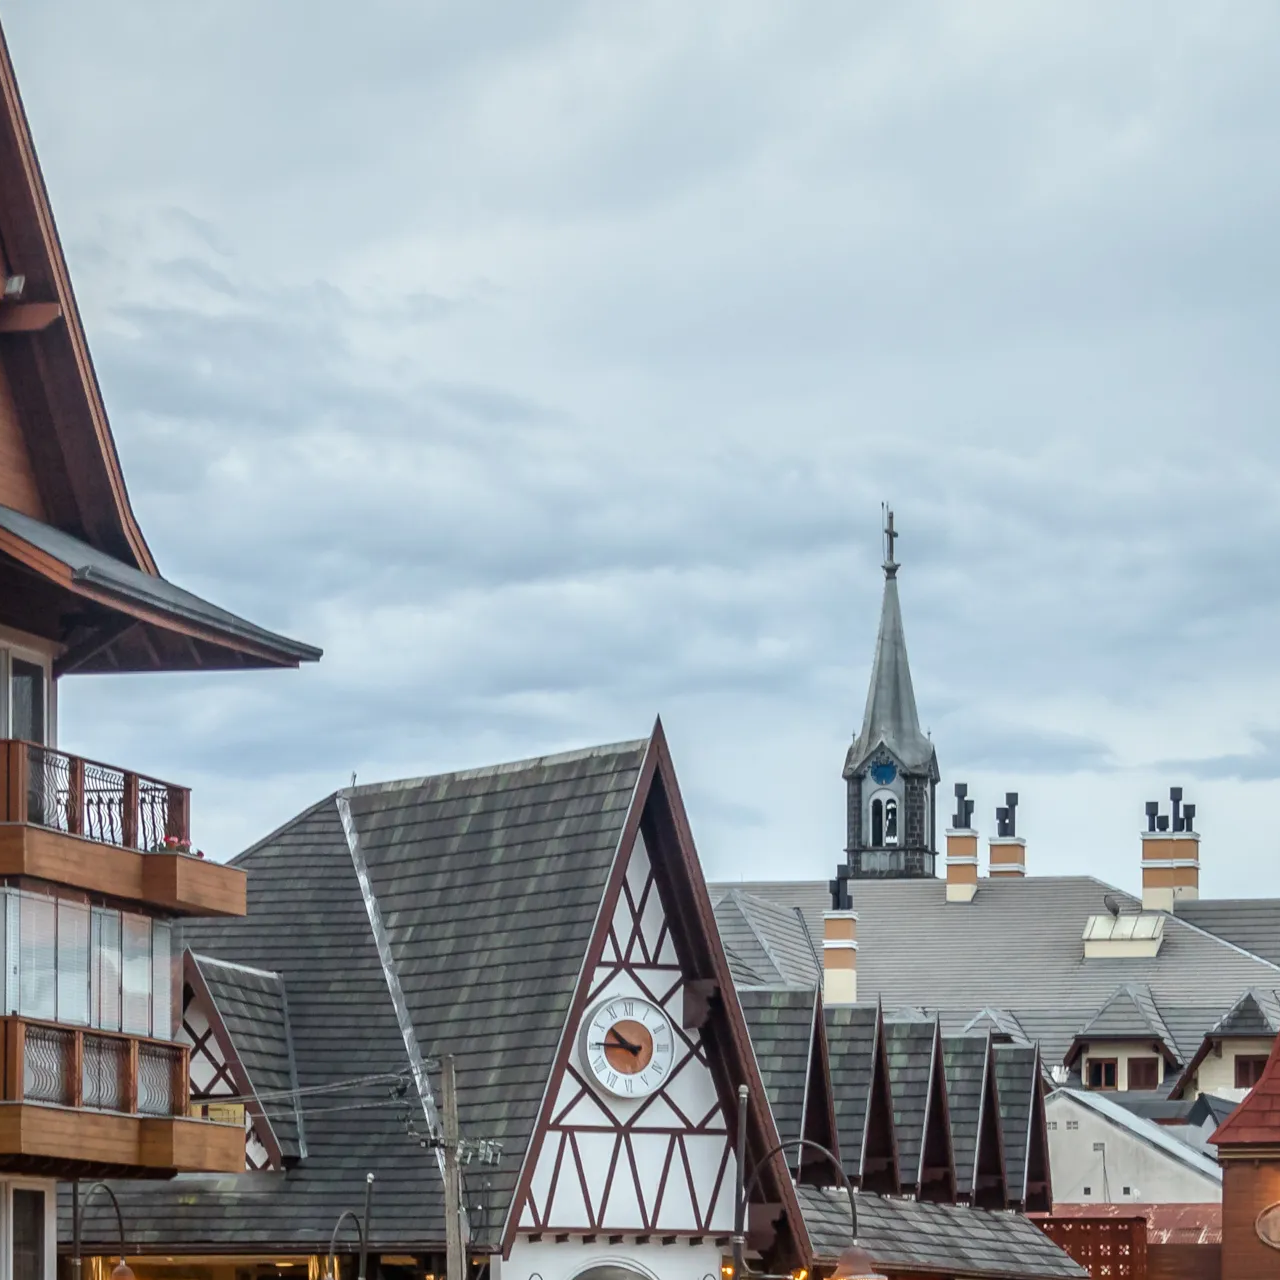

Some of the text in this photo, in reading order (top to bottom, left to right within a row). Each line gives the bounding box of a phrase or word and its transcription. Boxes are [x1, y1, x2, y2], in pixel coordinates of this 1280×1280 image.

[606, 1005, 618, 1020] XI
[623, 1002, 634, 1017] XII
[642, 1008, 650, 1020] I
[593, 1020, 605, 1032] X
[652, 1024, 666, 1034] II
[656, 1043, 669, 1053] III
[593, 1055, 607, 1074] VIII
[651, 1060, 663, 1075] IV
[606, 1071, 618, 1089] VII
[624, 1079, 633, 1094] VI
[640, 1073, 650, 1088] V
